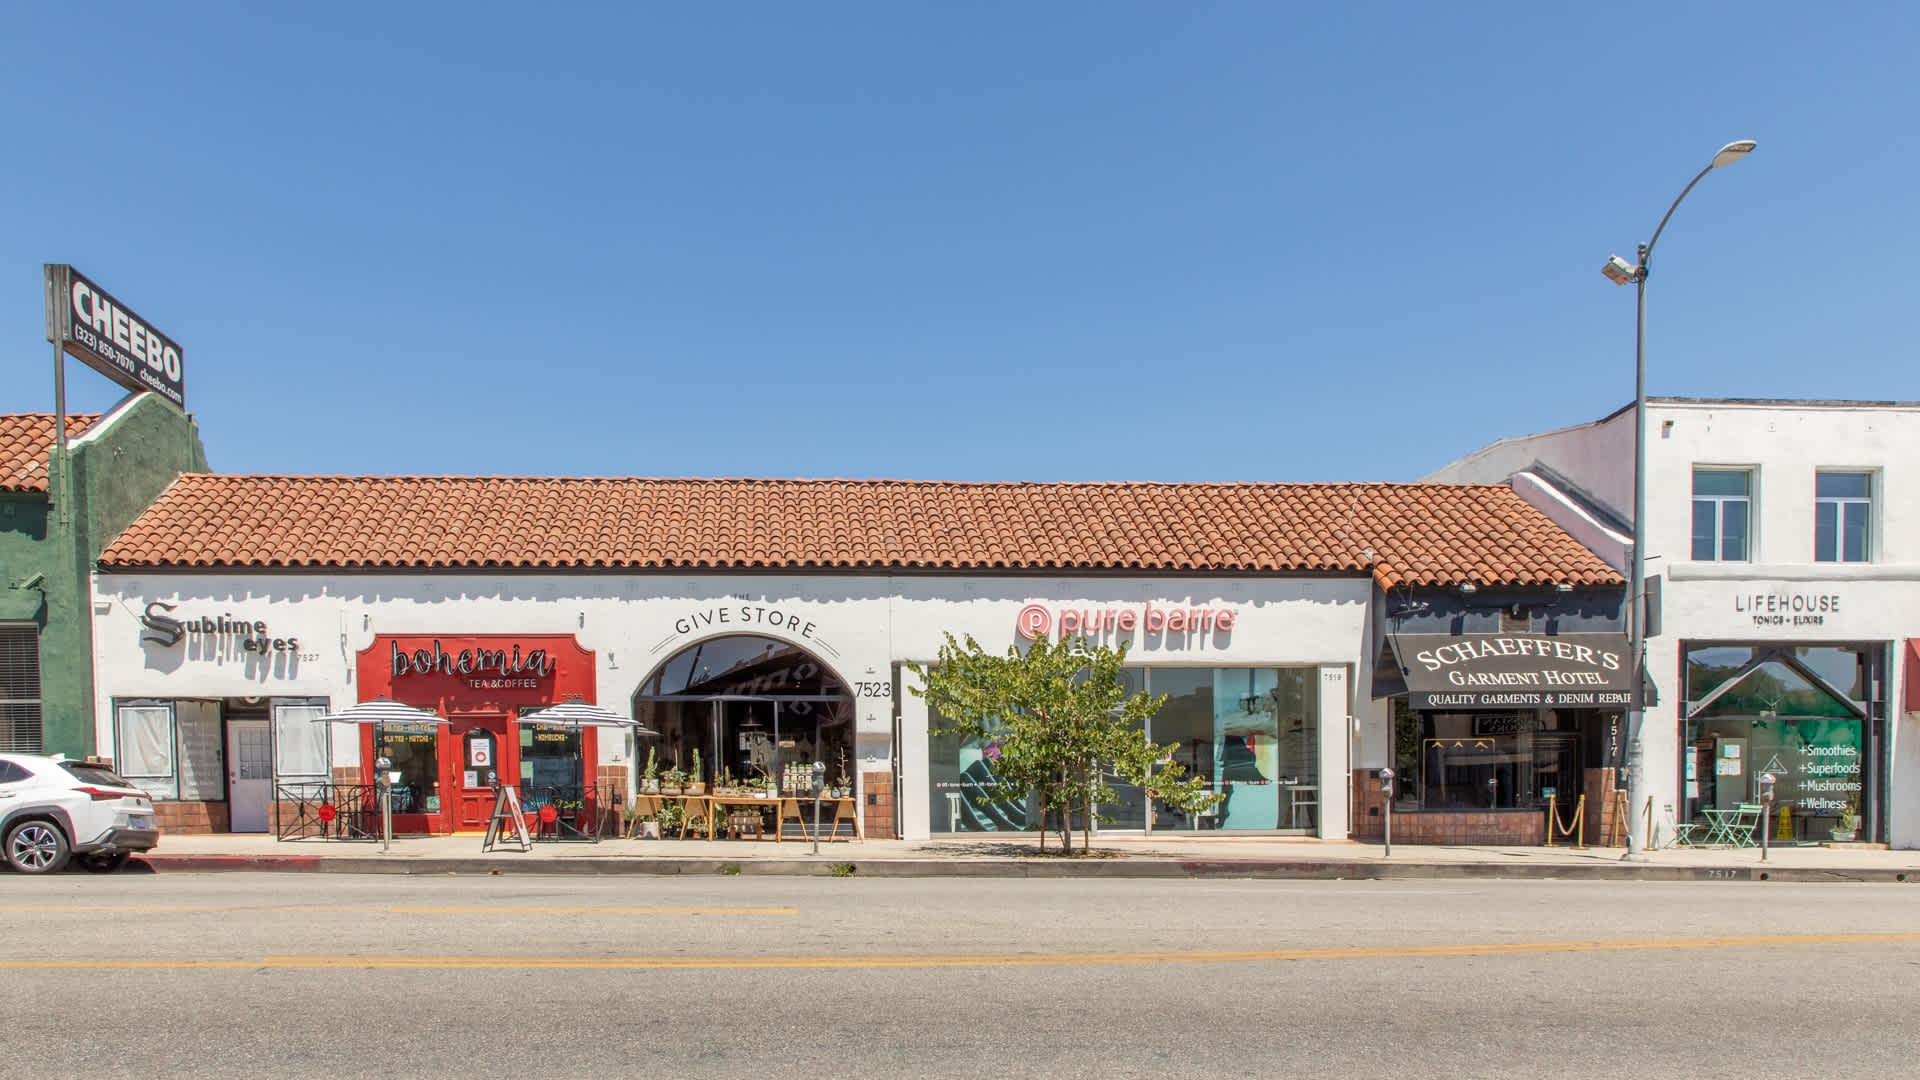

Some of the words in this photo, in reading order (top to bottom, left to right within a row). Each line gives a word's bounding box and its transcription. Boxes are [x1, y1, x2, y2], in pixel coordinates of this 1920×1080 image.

[72, 281, 181, 383] CHEEBO
[74, 324, 97, 351] (323)
[98, 340, 135, 373] 850-7070
[139, 368, 182, 403] cheebo.com
[1060, 609, 1137, 638] pure
[1146, 602, 1235, 631] barre
[1736, 595, 1840, 612] LIFEHOUSE
[1752, 615, 1784, 624] TONICS
[1793, 615, 1824, 624] ELIXIRS
[140, 602, 267, 647] Sublime
[675, 607, 730, 634] GIVE
[741, 606, 816, 640] STORE
[243, 637, 299, 655] eyes
[391, 640, 556, 677] bohemia
[1417, 638, 1620, 671] SCHAEFFER'S
[855, 682, 891, 698] 7523
[1449, 670, 1540, 686] GARMENT
[1543, 670, 1609, 686] HOTEL
[1428, 694, 1476, 706] QUALITY
[1481, 694, 1541, 705] GARMENTS
[1545, 694, 1554, 704] &
[1558, 694, 1594, 704] DENIM
[1611, 714, 1619, 757] 7517
[1707, 870, 1737, 880] 7517
